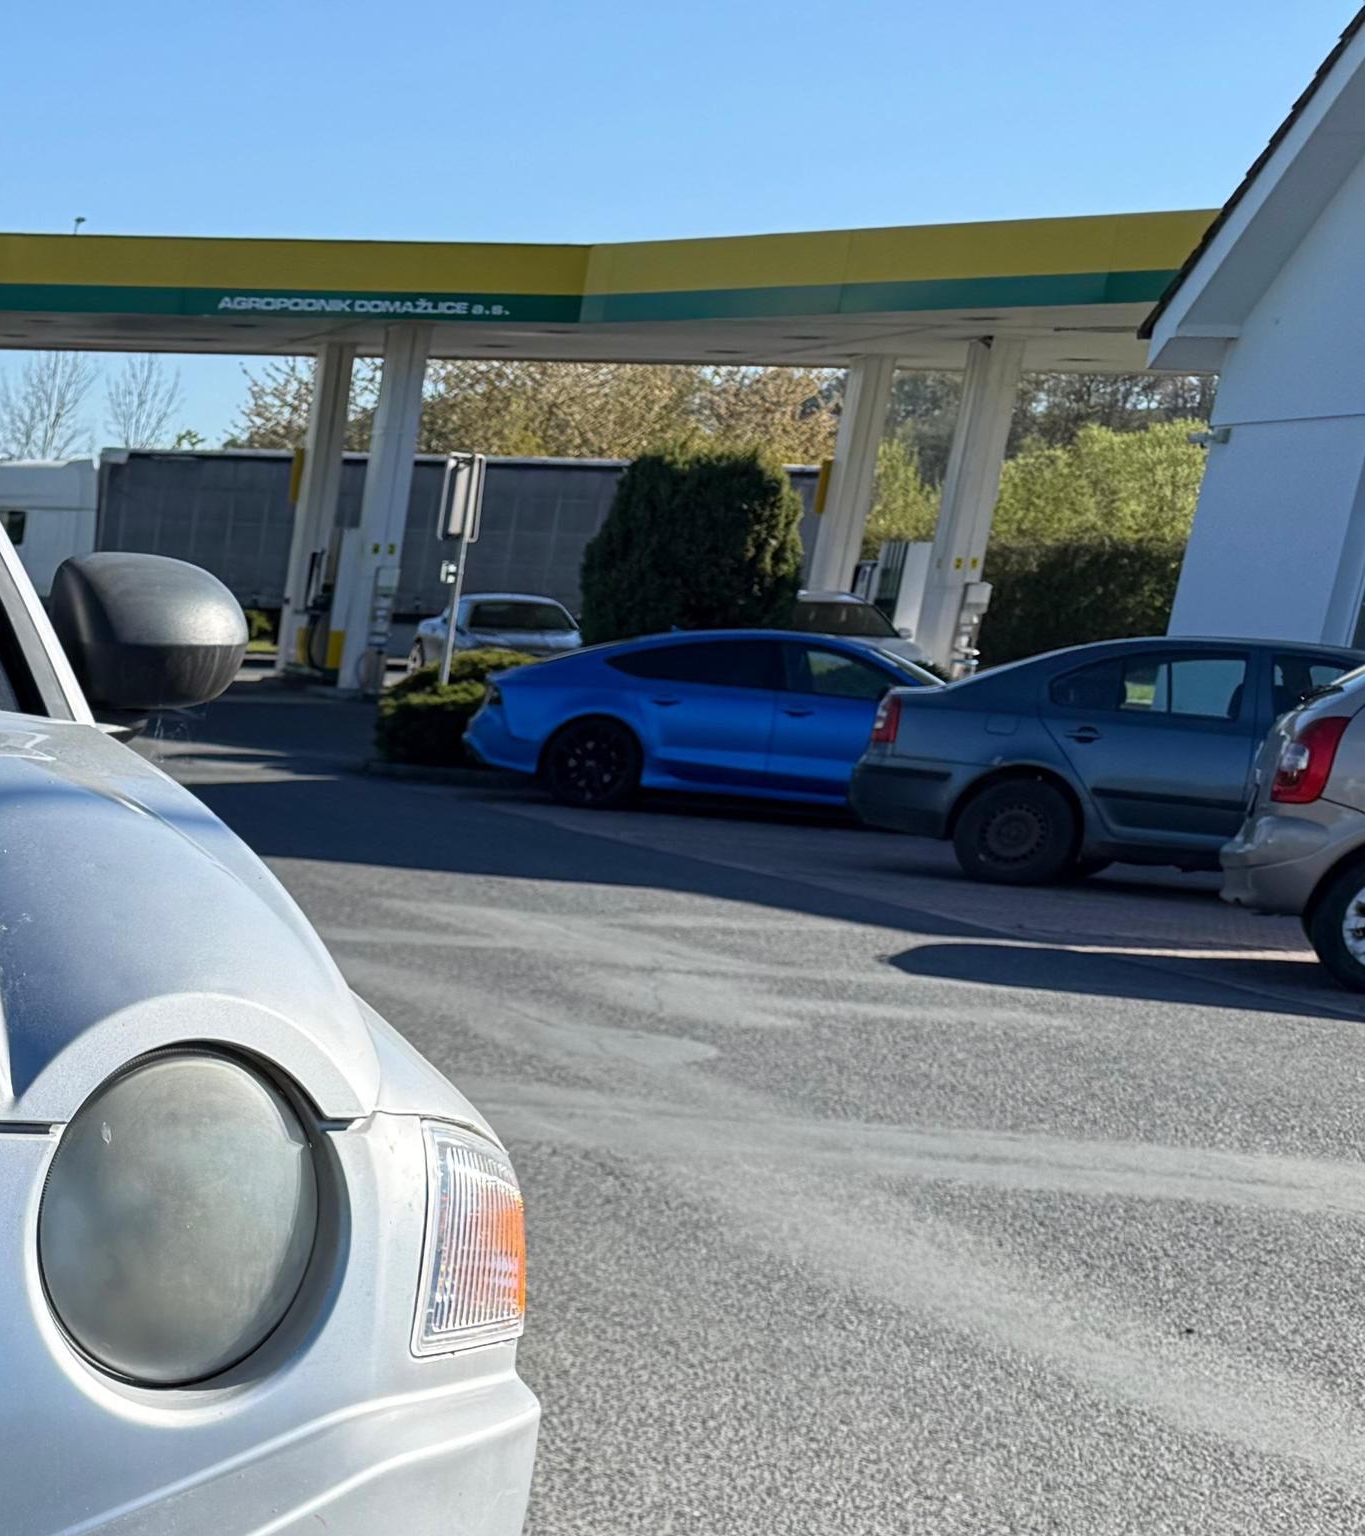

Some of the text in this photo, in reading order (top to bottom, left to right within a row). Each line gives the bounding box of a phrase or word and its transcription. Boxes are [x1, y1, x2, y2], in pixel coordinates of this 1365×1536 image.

[218, 296, 510, 315] AGROPODNIK DOMAŽLICE a.s.
